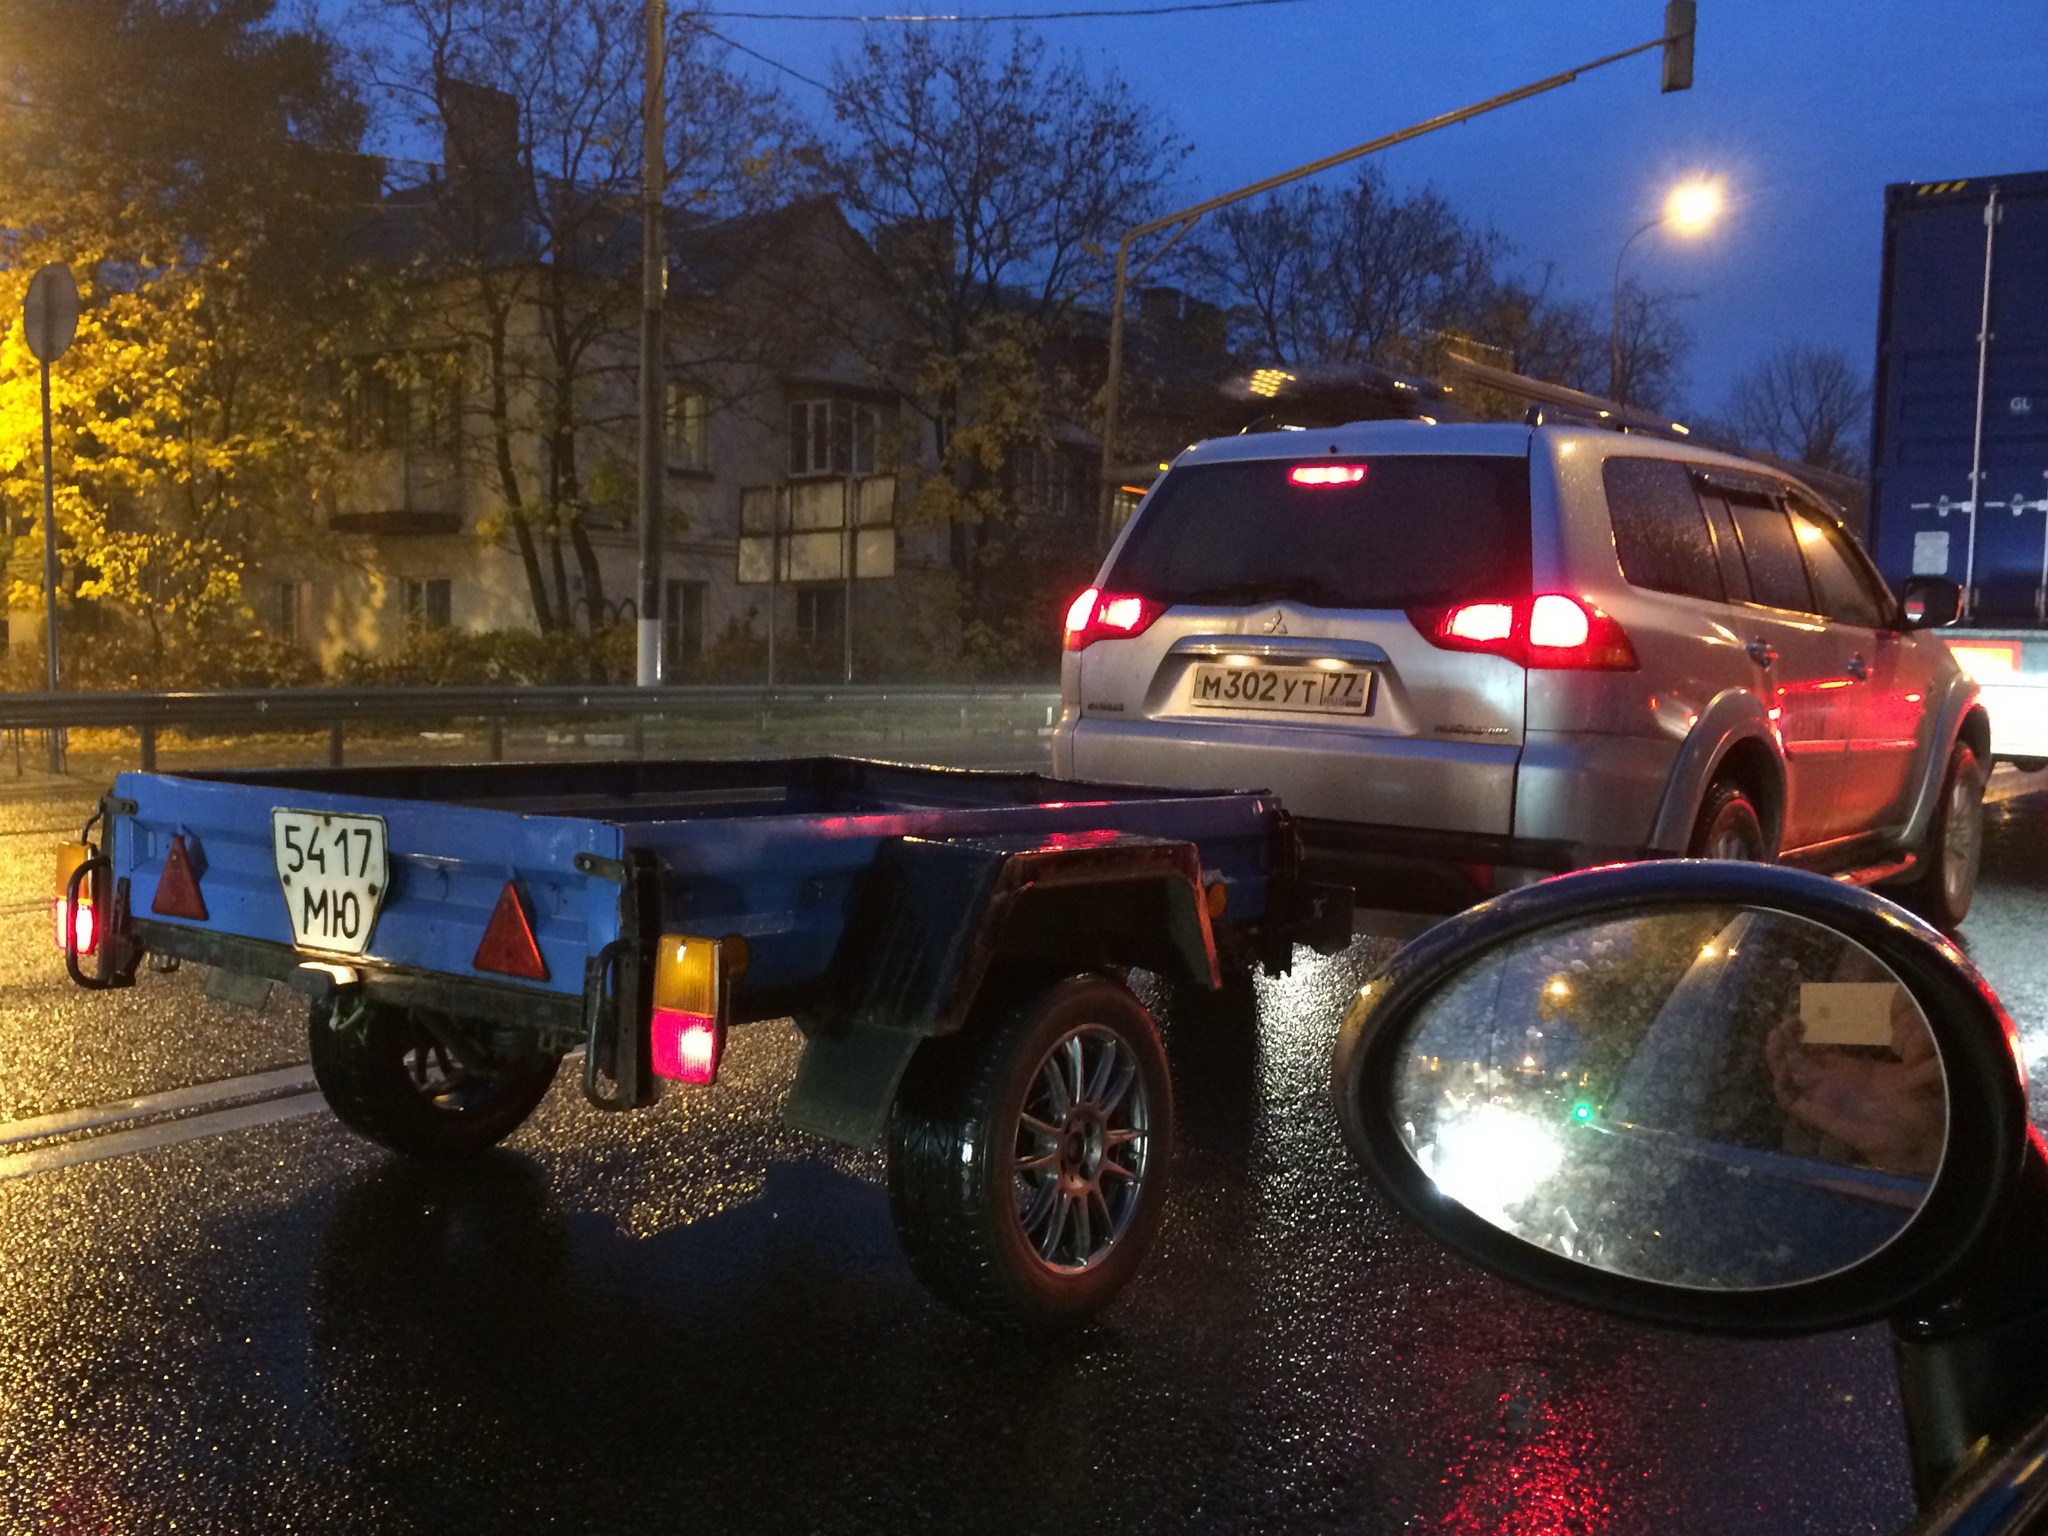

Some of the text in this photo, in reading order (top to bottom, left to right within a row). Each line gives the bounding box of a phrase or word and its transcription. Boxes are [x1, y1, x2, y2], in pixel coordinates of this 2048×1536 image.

[1202, 671, 1358, 703] М302УТ 77
[285, 825, 372, 878] 5417
[303, 886, 360, 939] МЮ
